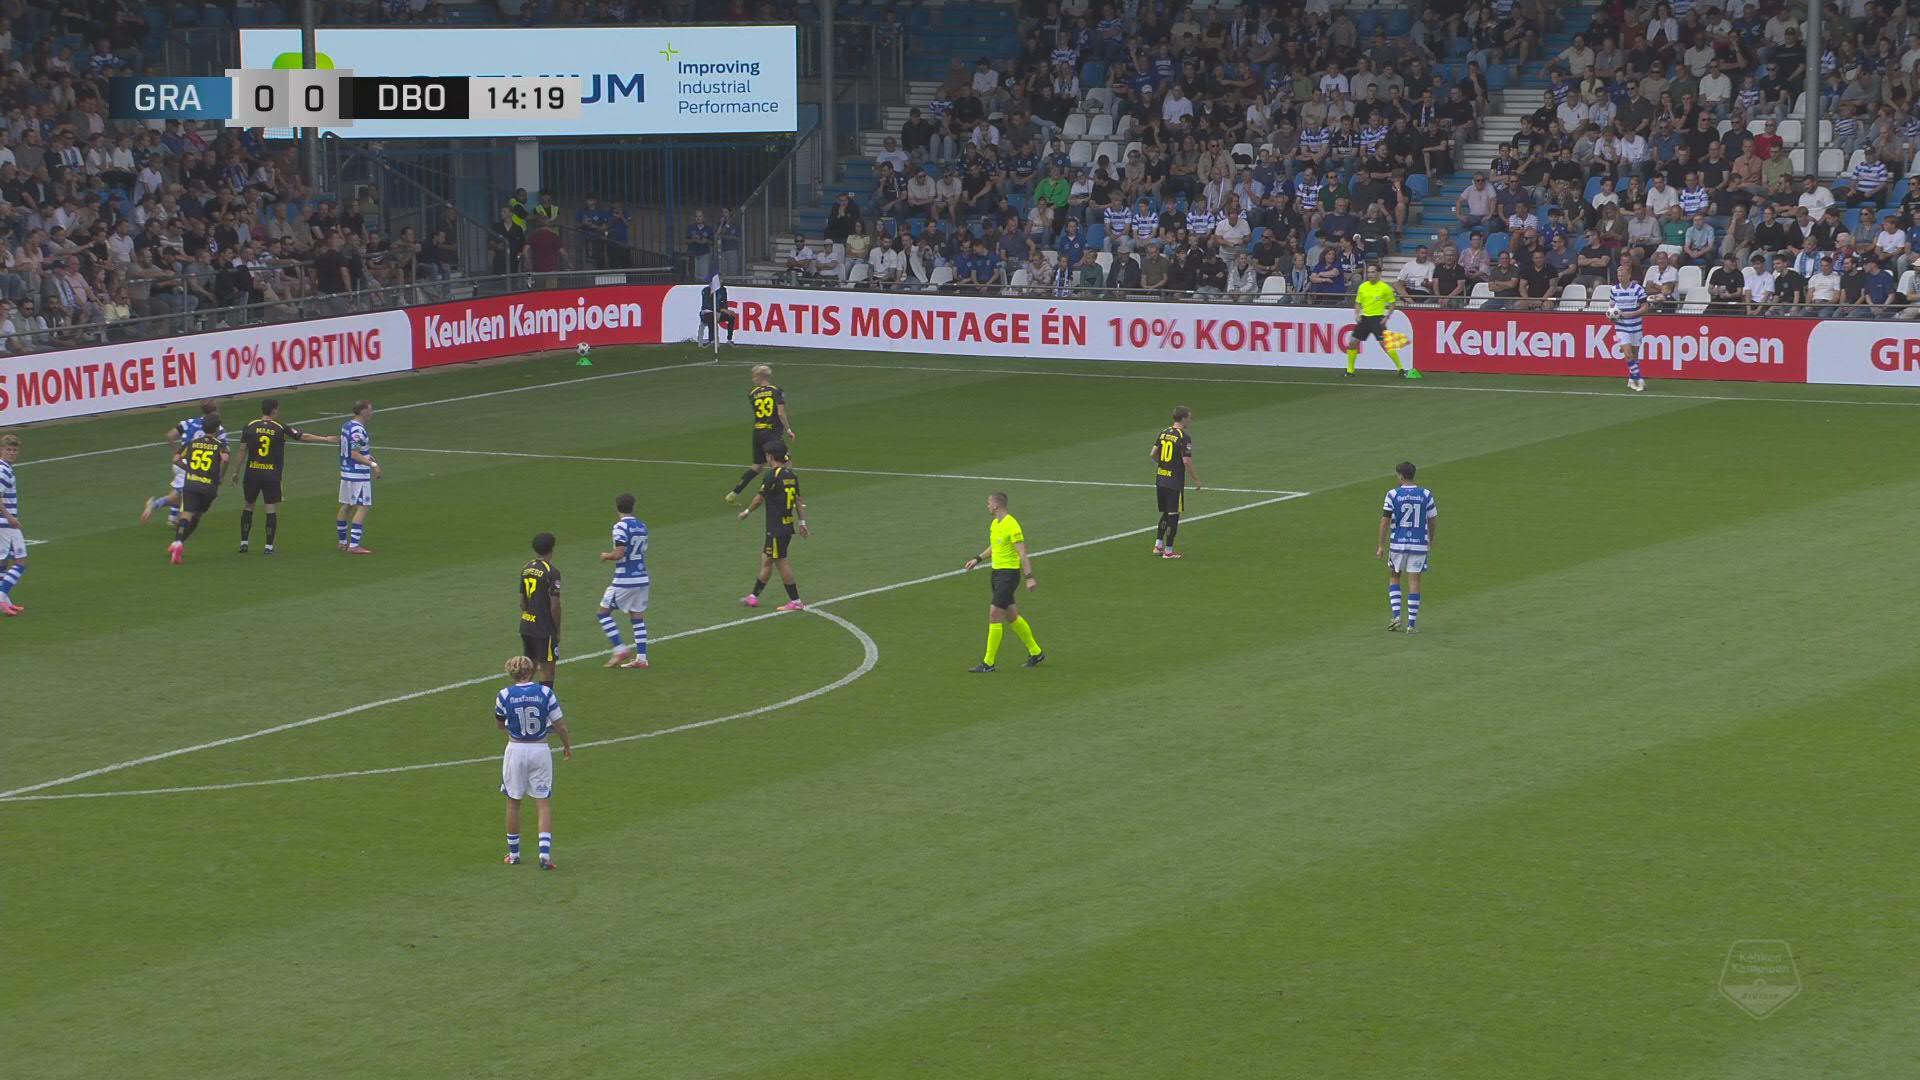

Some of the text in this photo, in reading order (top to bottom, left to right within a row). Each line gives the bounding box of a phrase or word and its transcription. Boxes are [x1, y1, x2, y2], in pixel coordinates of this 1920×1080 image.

[678, 60, 761, 77] Improving
[678, 80, 752, 95] Industrial
[678, 99, 780, 115] Performance
[424, 296, 643, 350] Keuken Kampioen
[851, 307, 1031, 344] MONTAGE
[1041, 307, 1087, 346] ÉN
[1109, 317, 1185, 350] 10%
[1435, 320, 1576, 359] Keuken
[17, 357, 156, 408] MONTAGE
[163, 347, 197, 389] ÉN
[211, 343, 266, 382] 10%
[272, 329, 381, 374] KORTING
[754, 397, 775, 419] 33
[258, 435, 271, 457] 3
[1160, 439, 1174, 463] 10
[189, 449, 214, 471] 55
[1399, 503, 1421, 529] 21
[523, 577, 538, 599] 17
[514, 705, 541, 736] 16
